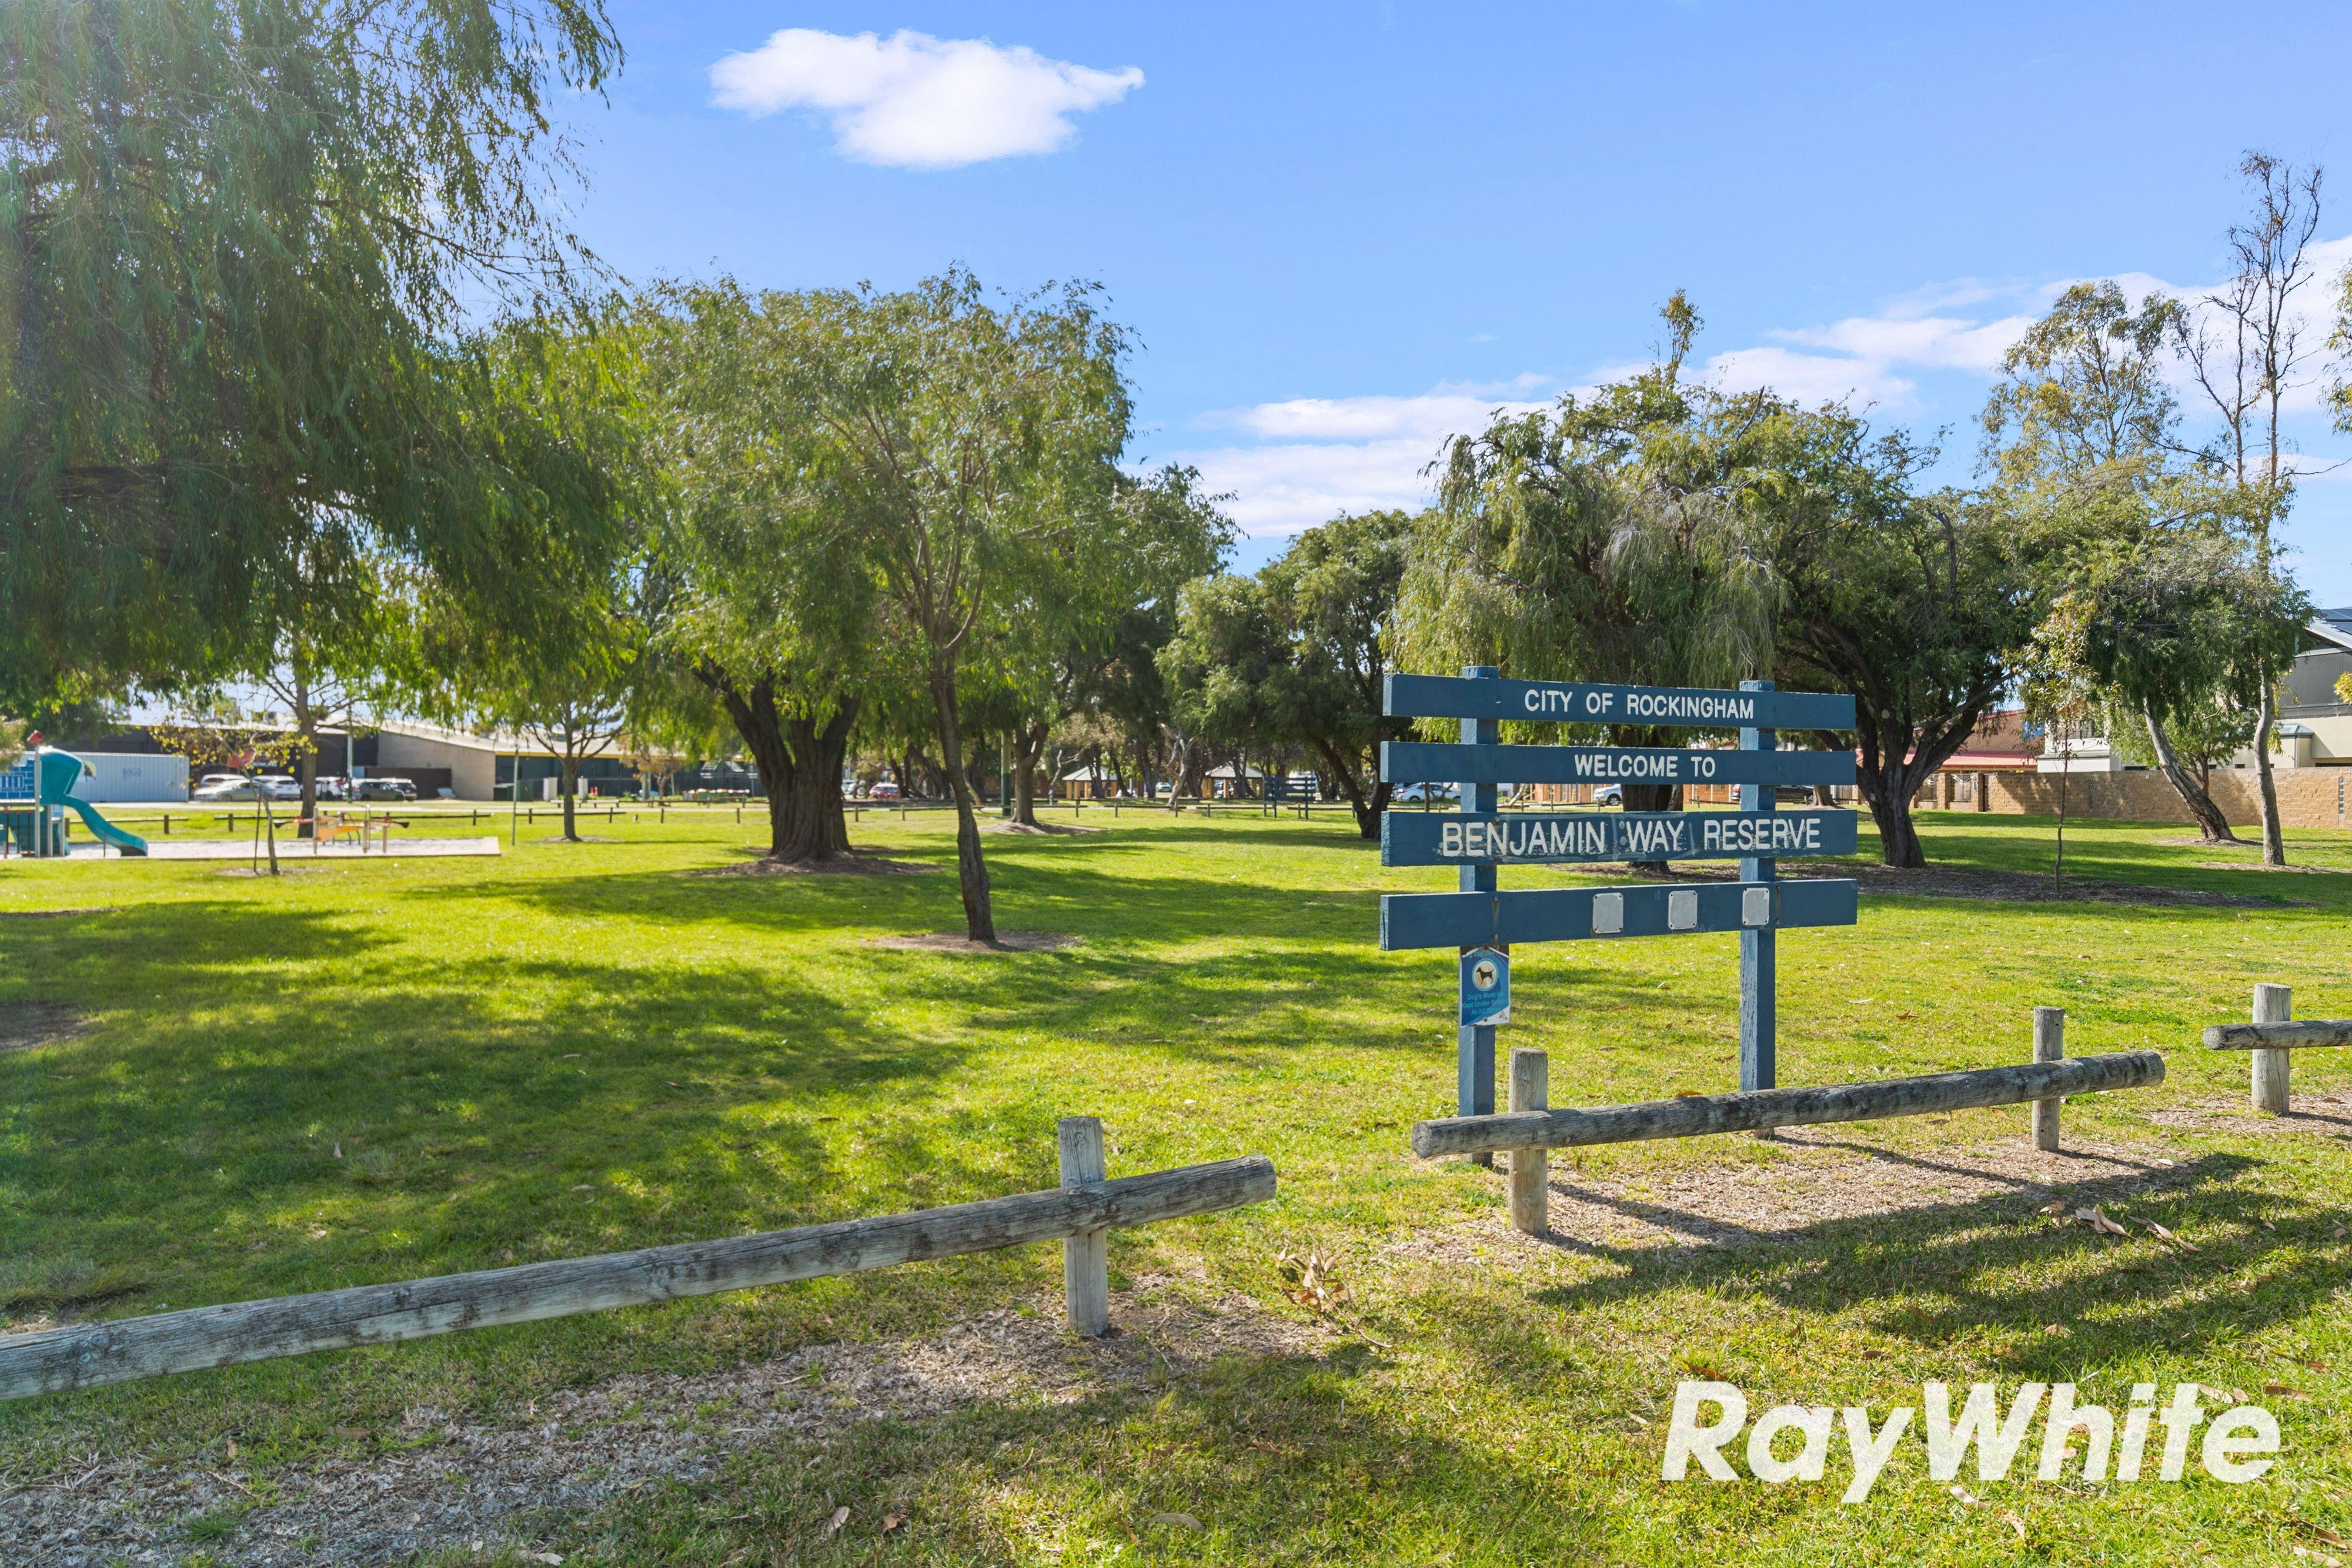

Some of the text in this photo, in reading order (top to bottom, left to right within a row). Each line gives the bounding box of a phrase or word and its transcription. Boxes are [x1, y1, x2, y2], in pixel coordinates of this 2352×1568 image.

[1525, 689, 1753, 719] CITY OF ROCKINGHAM
[1575, 754, 1716, 777] WELCOME TO
[1442, 818, 1821, 857] BENJAMIN WAY RESERVE
